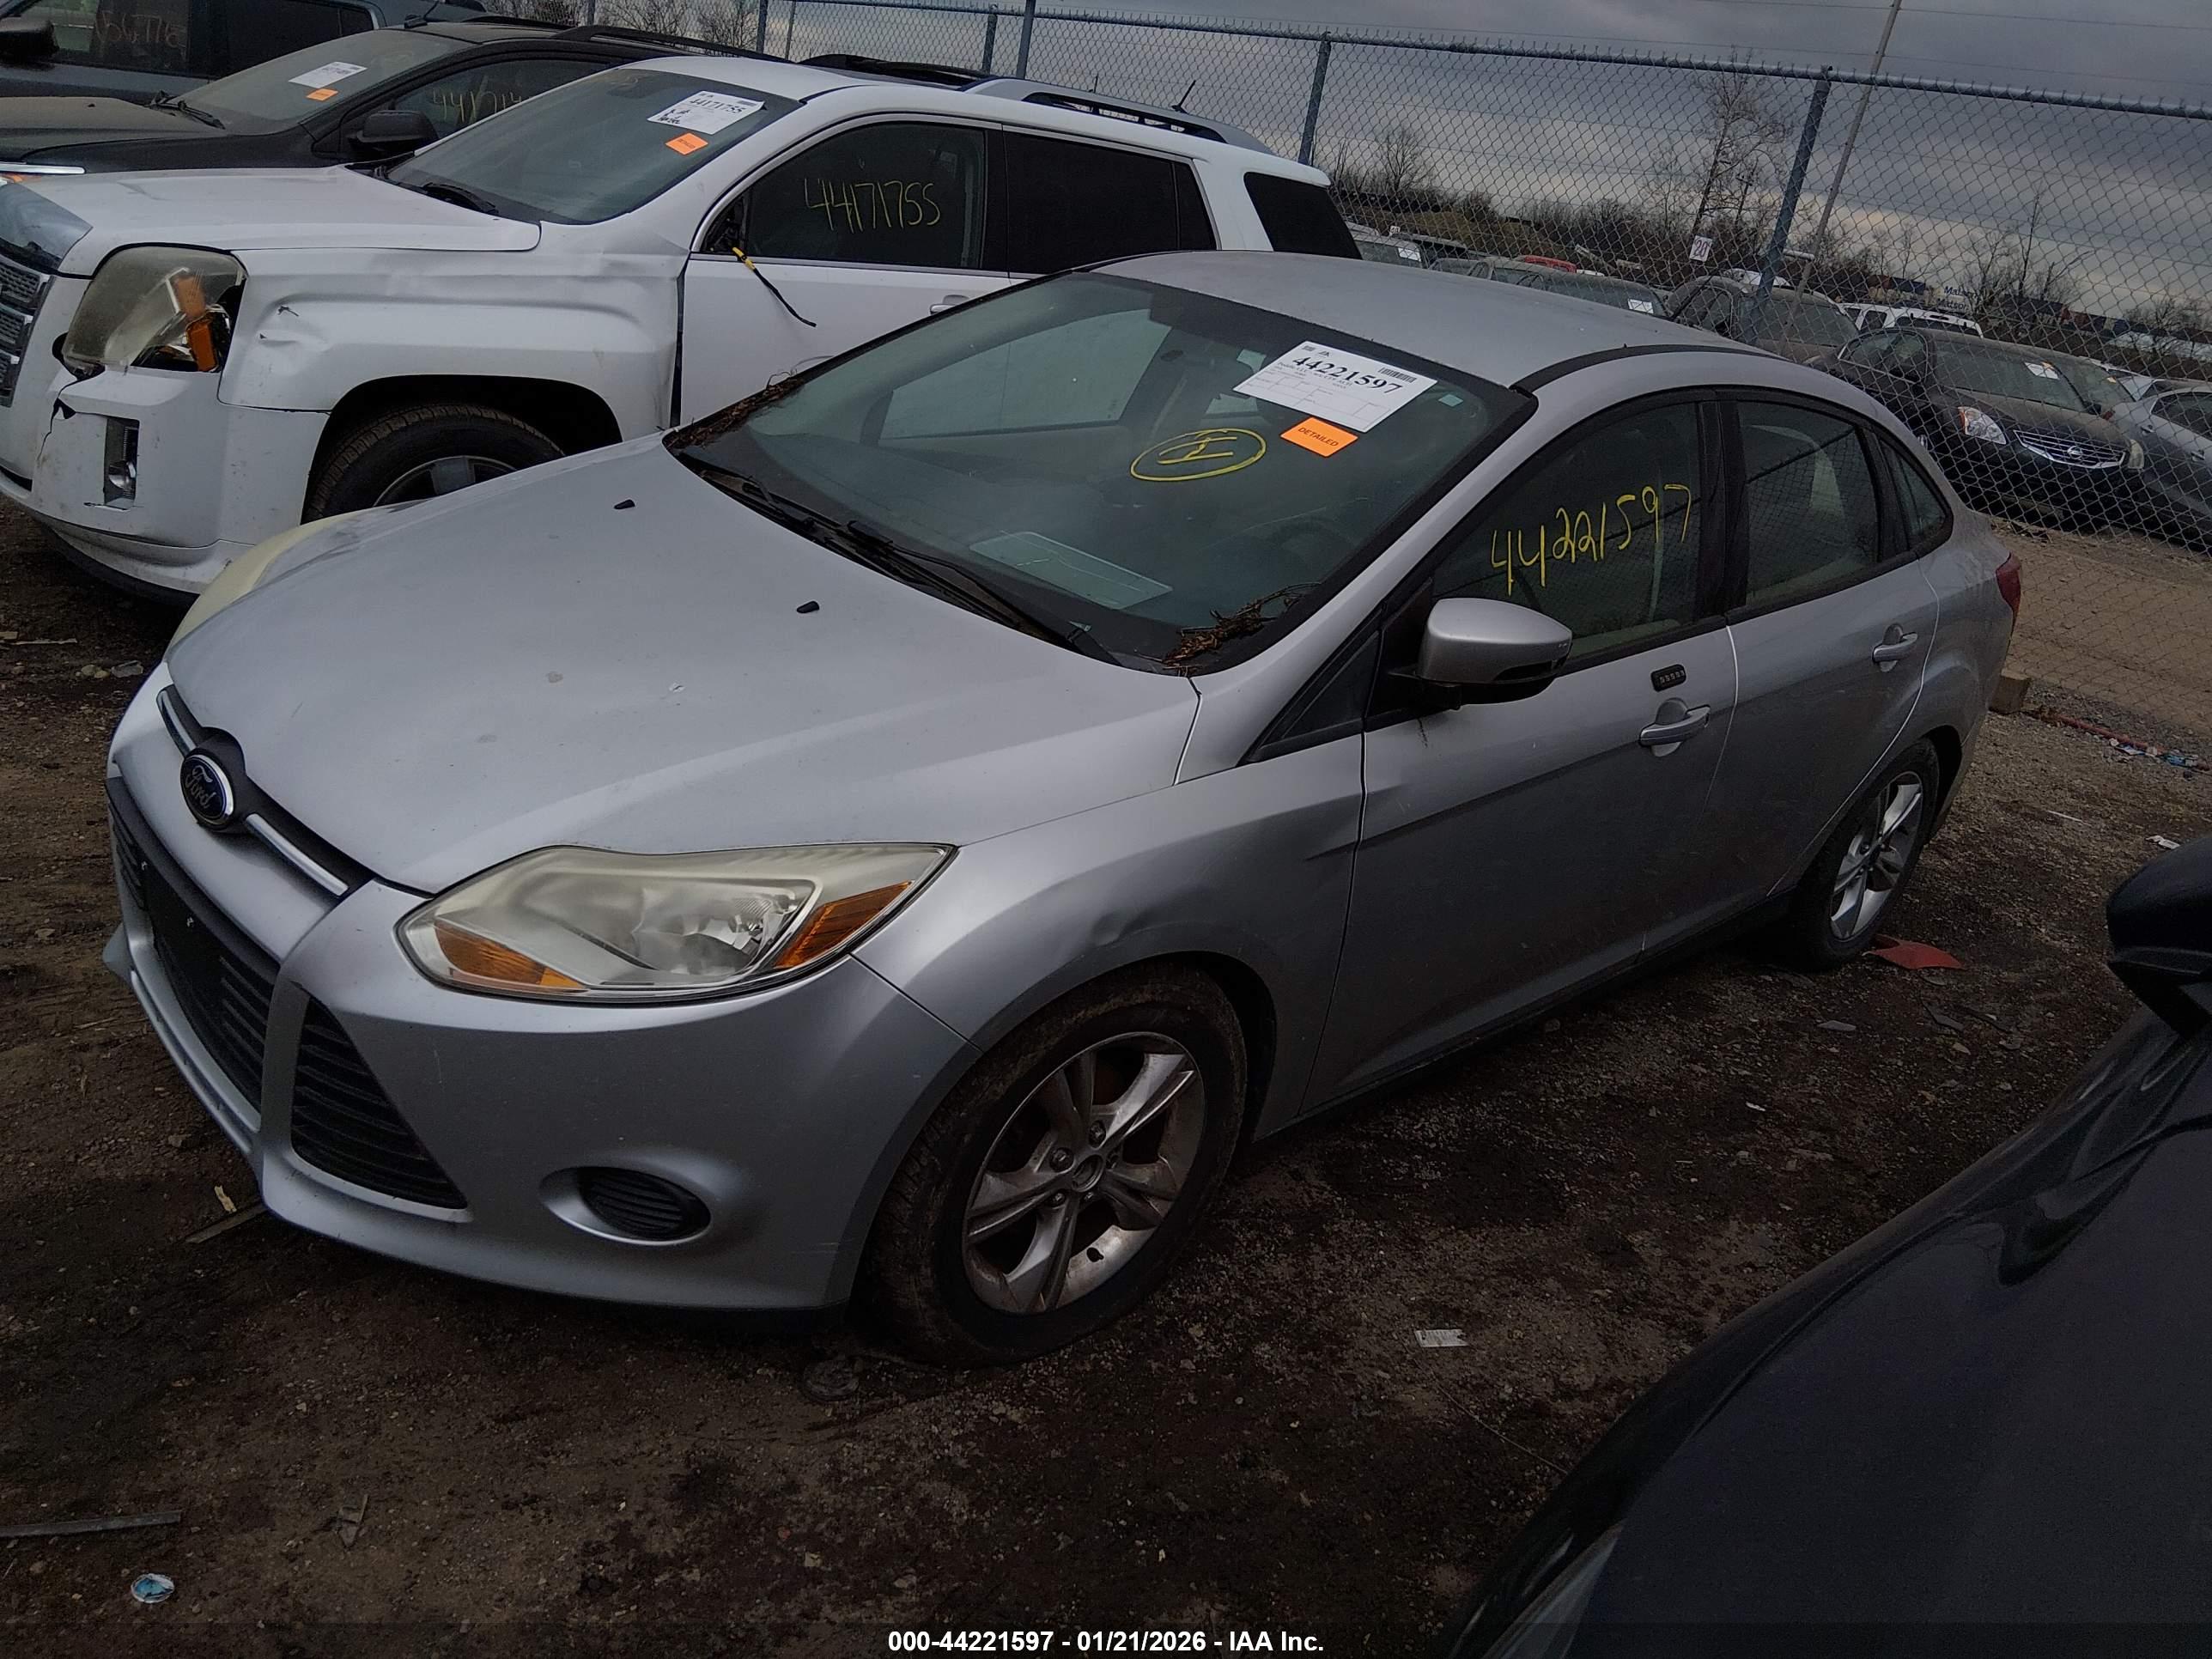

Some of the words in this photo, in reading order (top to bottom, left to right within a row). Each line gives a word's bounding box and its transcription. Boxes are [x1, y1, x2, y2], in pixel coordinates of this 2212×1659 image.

[804, 178, 941, 234] 44171755
[1292, 356, 1403, 393] 44221597
[1297, 427, 1340, 447] DETAILED
[1491, 484, 1692, 597] 44221597
[185, 765, 216, 809] Ford
